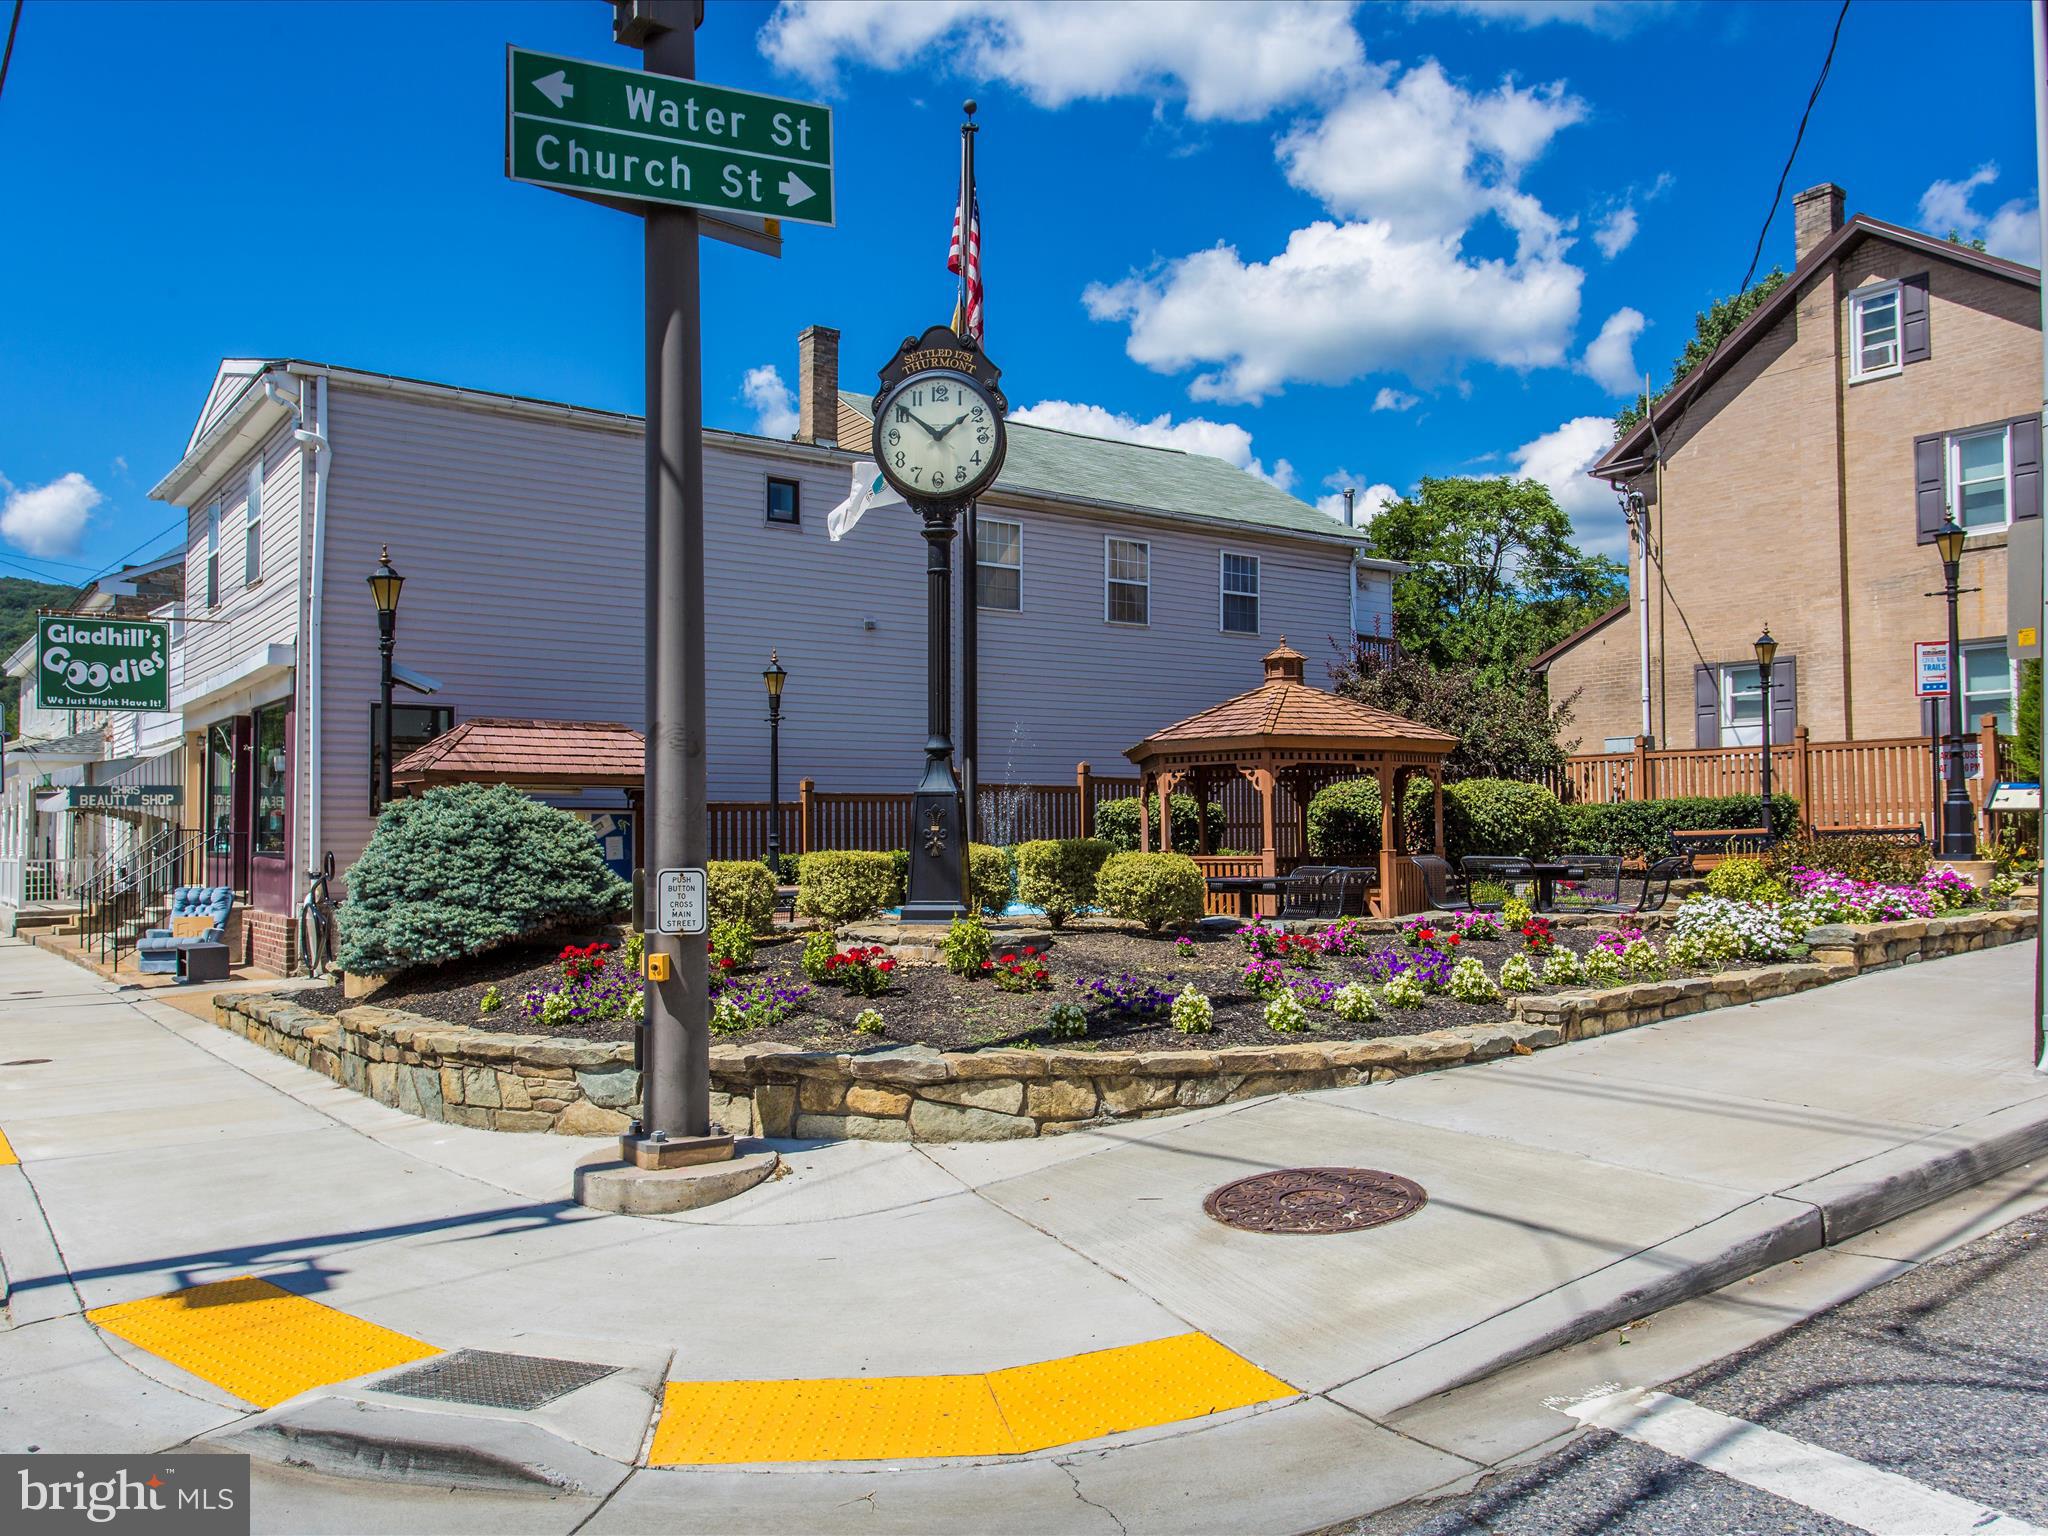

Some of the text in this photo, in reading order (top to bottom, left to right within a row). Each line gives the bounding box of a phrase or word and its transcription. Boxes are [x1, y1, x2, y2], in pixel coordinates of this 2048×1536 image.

[625, 84, 812, 150] Water St
[535, 134, 763, 202] Church St
[904, 348, 974, 364] SETTLED 1751
[902, 357, 977, 375] THURMONT
[912, 390, 923, 407] 11
[931, 384, 949, 402] 12
[958, 390, 962, 406] 1
[970, 405, 983, 423] 2
[888, 428, 901, 446] 9
[976, 426, 990, 444] 3
[895, 450, 906, 468] 8
[969, 450, 982, 466] 4
[910, 466, 923, 484] 7
[931, 471, 945, 488] 6
[955, 465, 967, 483] 5
[47, 624, 161, 648] Gladhill's
[42, 646, 165, 688] Goodies
[1923, 663, 1947, 671] TRAILS
[47, 696, 161, 708] We Just Might Have It!
[80, 794, 174, 806] BEAUTY SHOP
